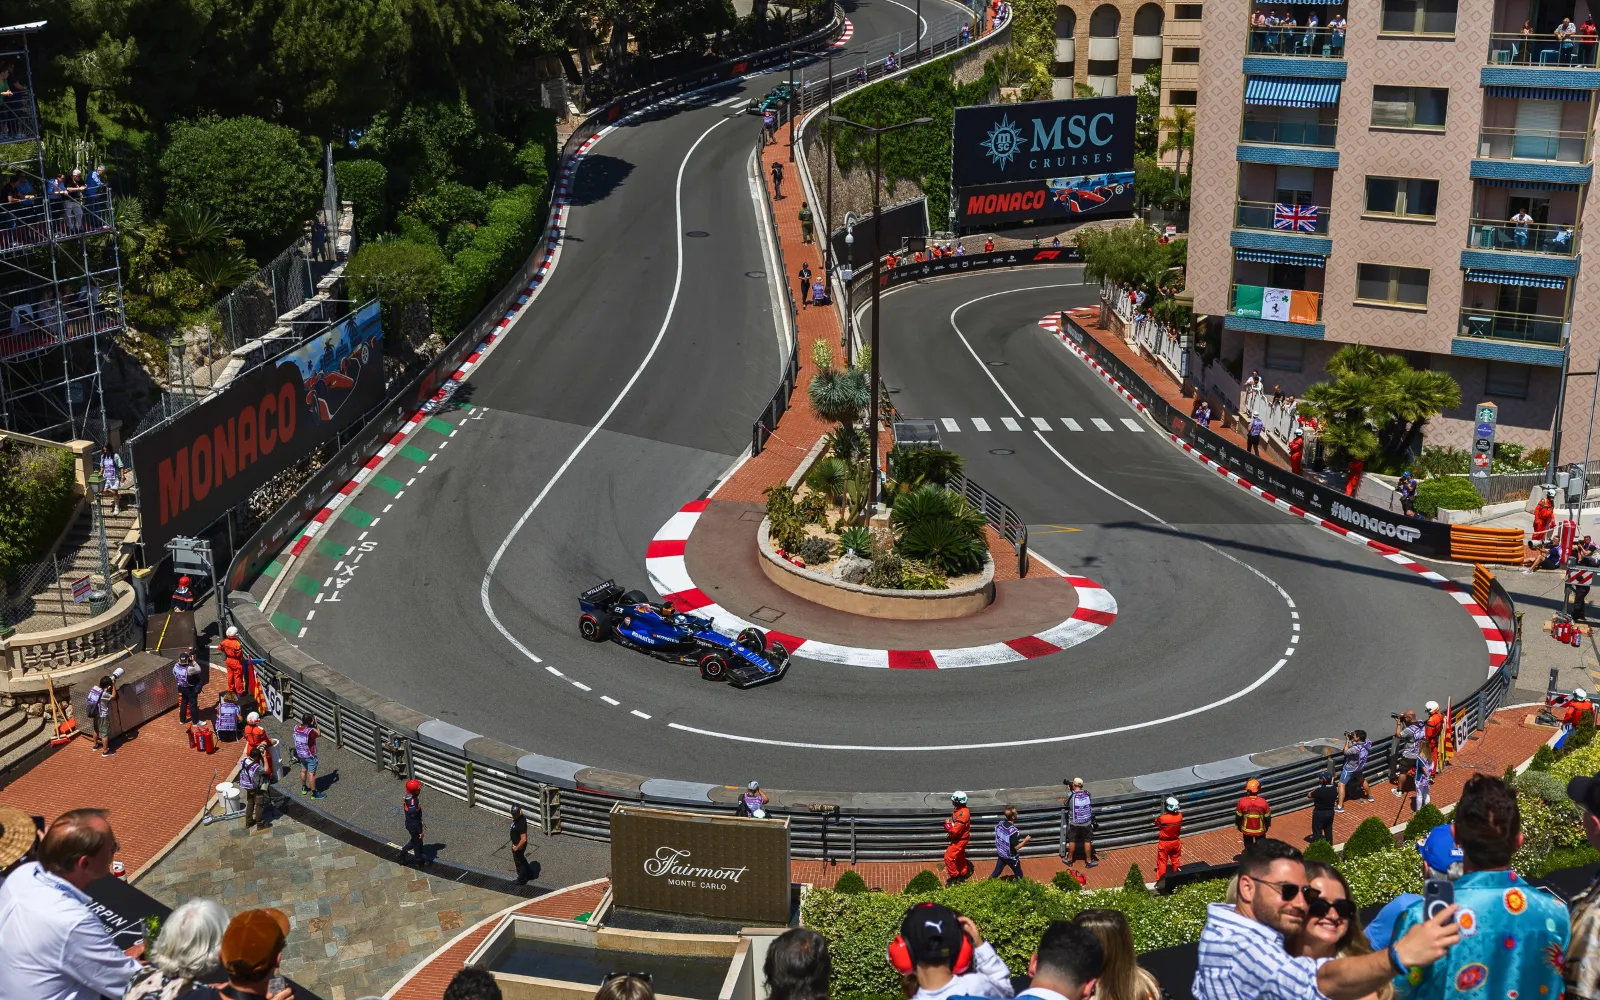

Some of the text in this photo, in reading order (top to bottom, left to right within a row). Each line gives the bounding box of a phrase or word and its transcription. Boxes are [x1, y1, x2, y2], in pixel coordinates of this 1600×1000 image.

[1030, 113, 1114, 152] MSC
[1029, 152, 1112, 169] CRUISES
[966, 189, 1046, 216] MONACO
[158, 381, 296, 526] MONACO
[1331, 501, 1421, 543] #MonacoGP
[323, 541, 378, 602] TAXIS
[587, 582, 610, 595] WILLIAMS
[631, 630, 655, 645] KOMATSU
[1457, 721, 1467, 745] SC
[643, 846, 750, 883] Fairmont
[668, 878, 727, 891] MONTE CARLO
[88, 901, 128, 927] IRPIN
